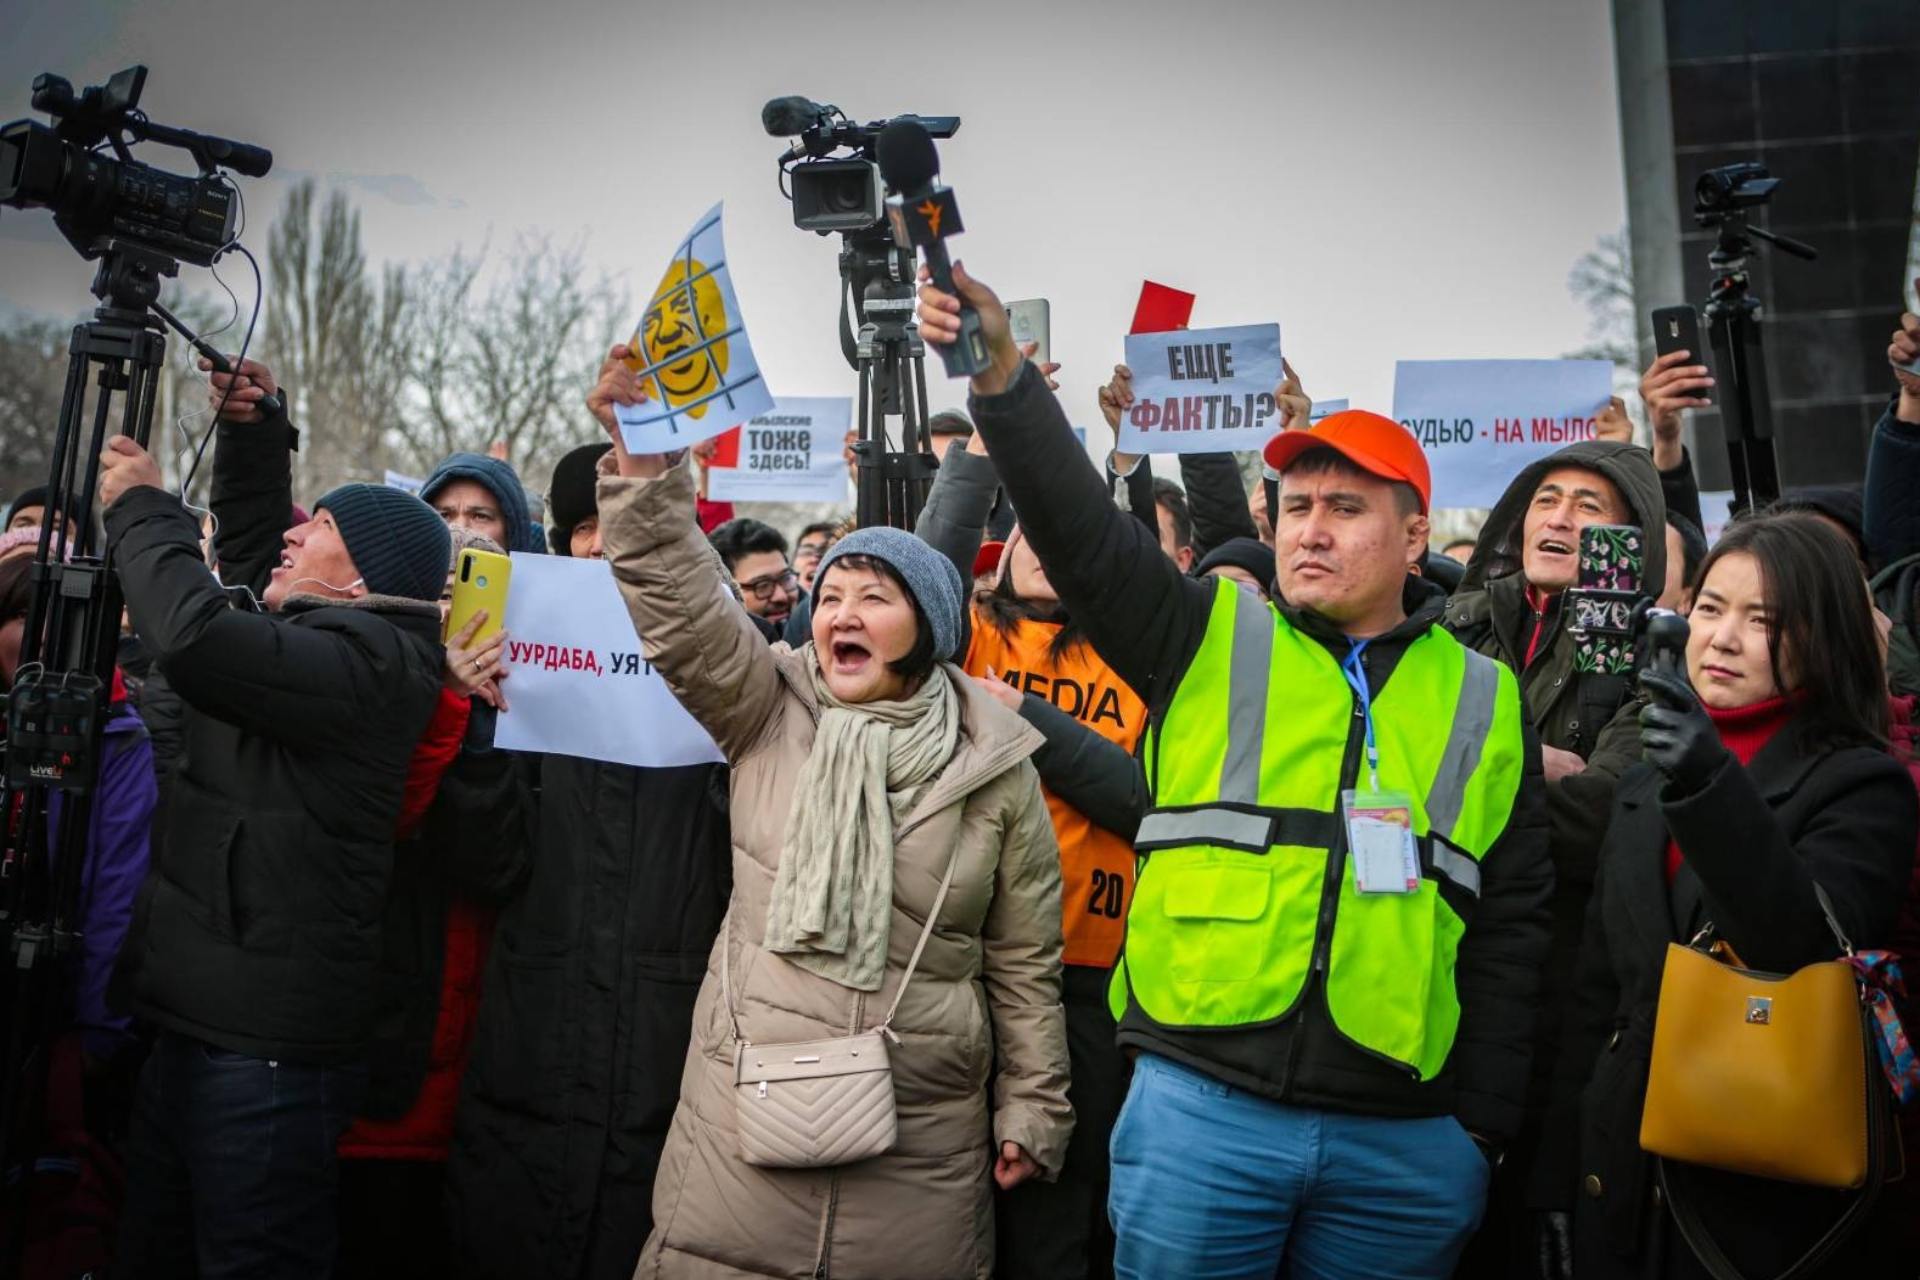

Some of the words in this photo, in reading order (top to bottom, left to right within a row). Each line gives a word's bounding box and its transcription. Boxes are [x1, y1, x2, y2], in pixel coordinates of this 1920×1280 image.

[1167, 343, 1235, 384] ЕЩЕ
[1130, 392, 1276, 432] ФАКТЫ?
[748, 430, 811, 451] тоже
[1494, 418, 1524, 443] НА
[749, 452, 810, 472] здесь!
[509, 641, 603, 677] УУРДАБА,
[1088, 868, 1124, 919] 20
